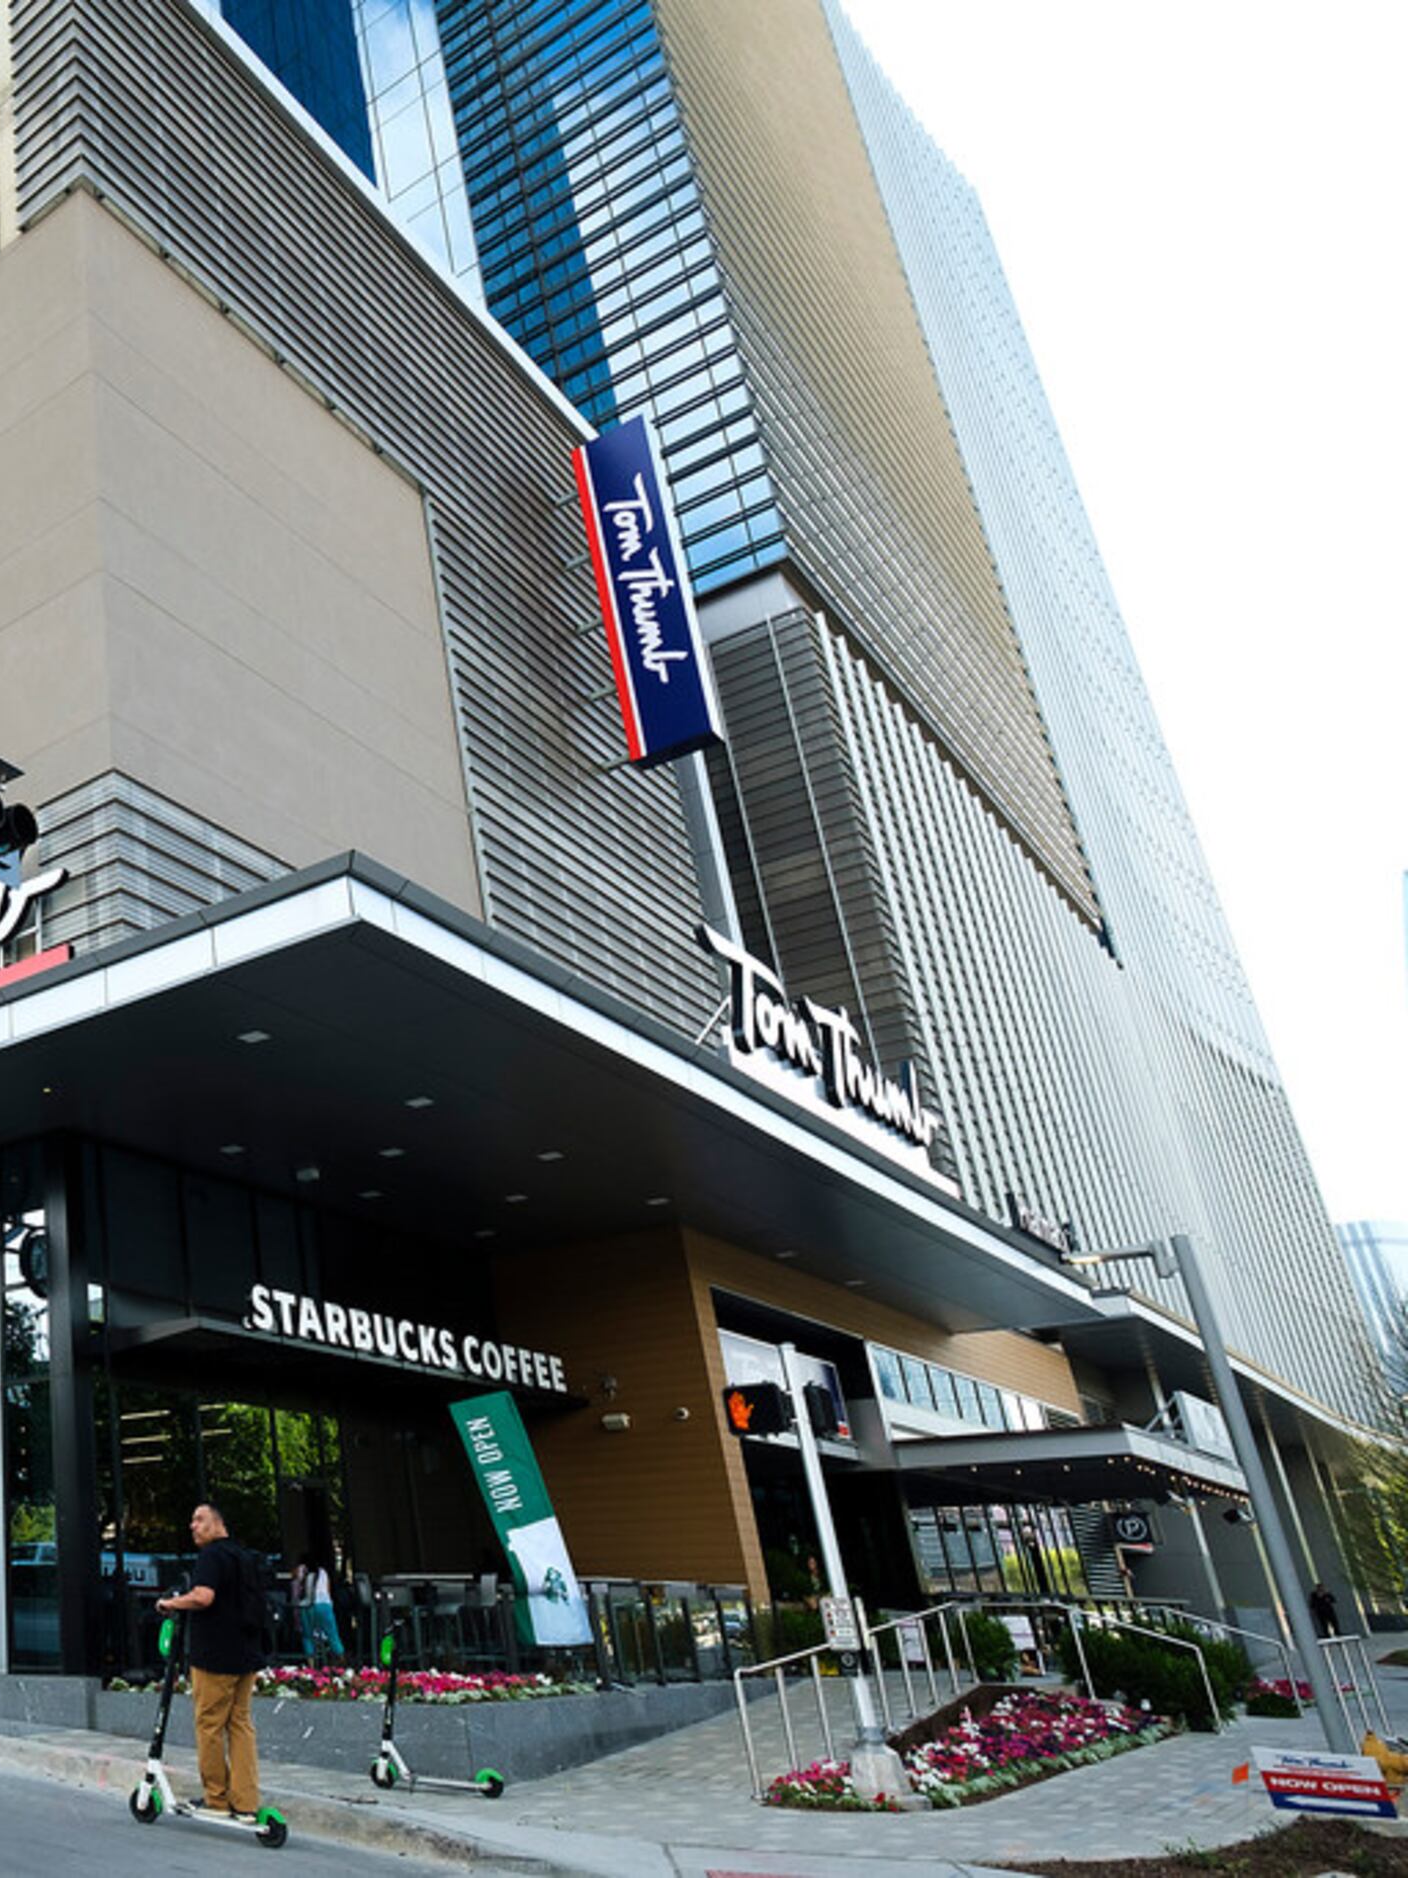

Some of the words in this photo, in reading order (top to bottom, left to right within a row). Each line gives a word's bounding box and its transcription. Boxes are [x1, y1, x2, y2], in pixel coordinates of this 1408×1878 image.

[603, 473, 653, 562] Tom
[617, 546, 689, 684] Thumb
[694, 922, 819, 1074] Tom
[802, 996, 943, 1148] Thumb
[250, 1283, 458, 1371] STARBUCKS
[462, 1334, 568, 1393] COFFEE
[466, 1415, 503, 1465] OPEN
[483, 1469, 523, 1513] NOW
